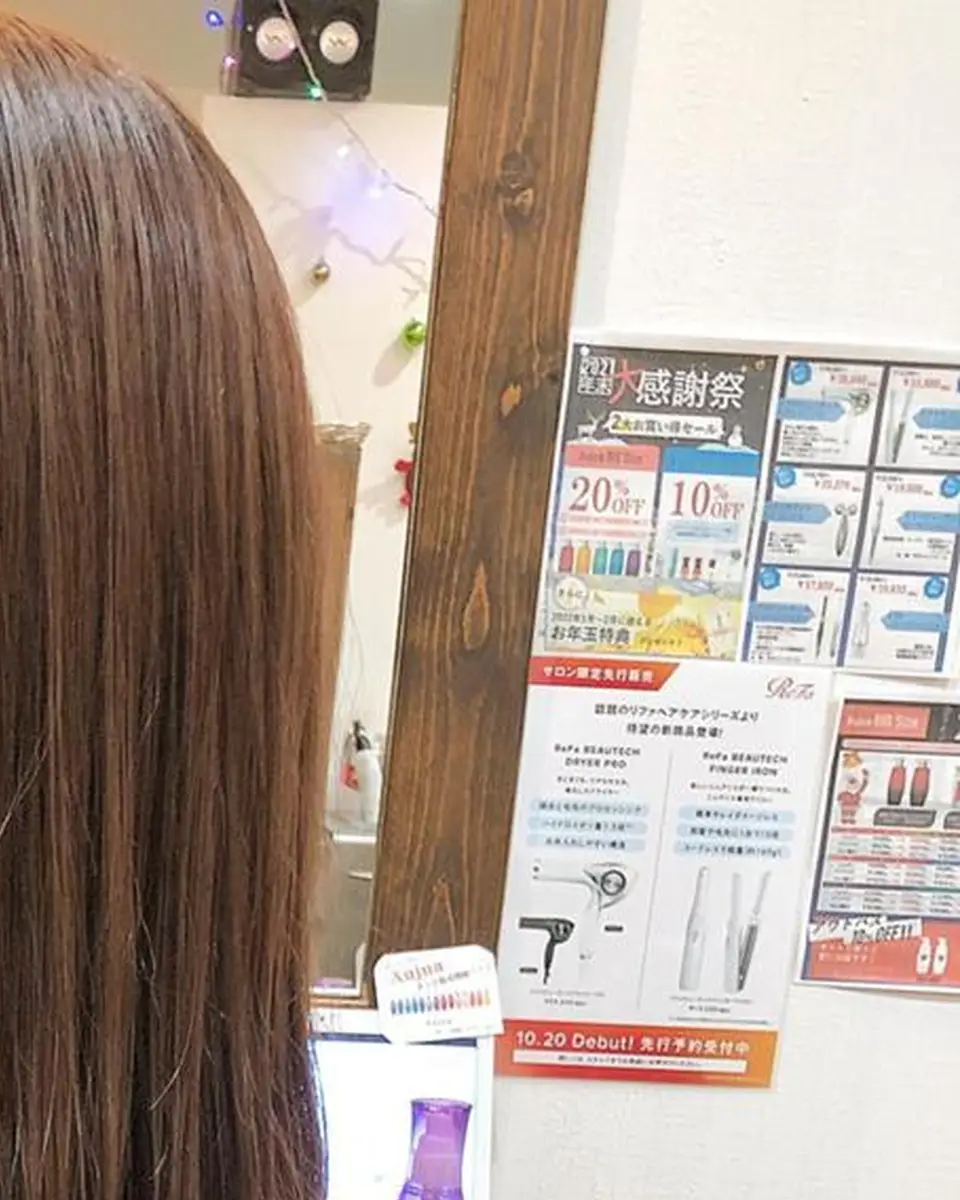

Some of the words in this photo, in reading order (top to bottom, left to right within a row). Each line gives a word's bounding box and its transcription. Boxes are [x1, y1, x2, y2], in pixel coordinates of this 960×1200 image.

[608, 358, 746, 409] 大感謝祭
[612, 499, 646, 515] OFF
[710, 501, 745, 519] OFF
[551, 626, 630, 645] お年玉特典
[583, 745, 641, 756] BEAUTECH
[516, 1030, 567, 1048] 10.20
[572, 1034, 634, 1051] Debut!
